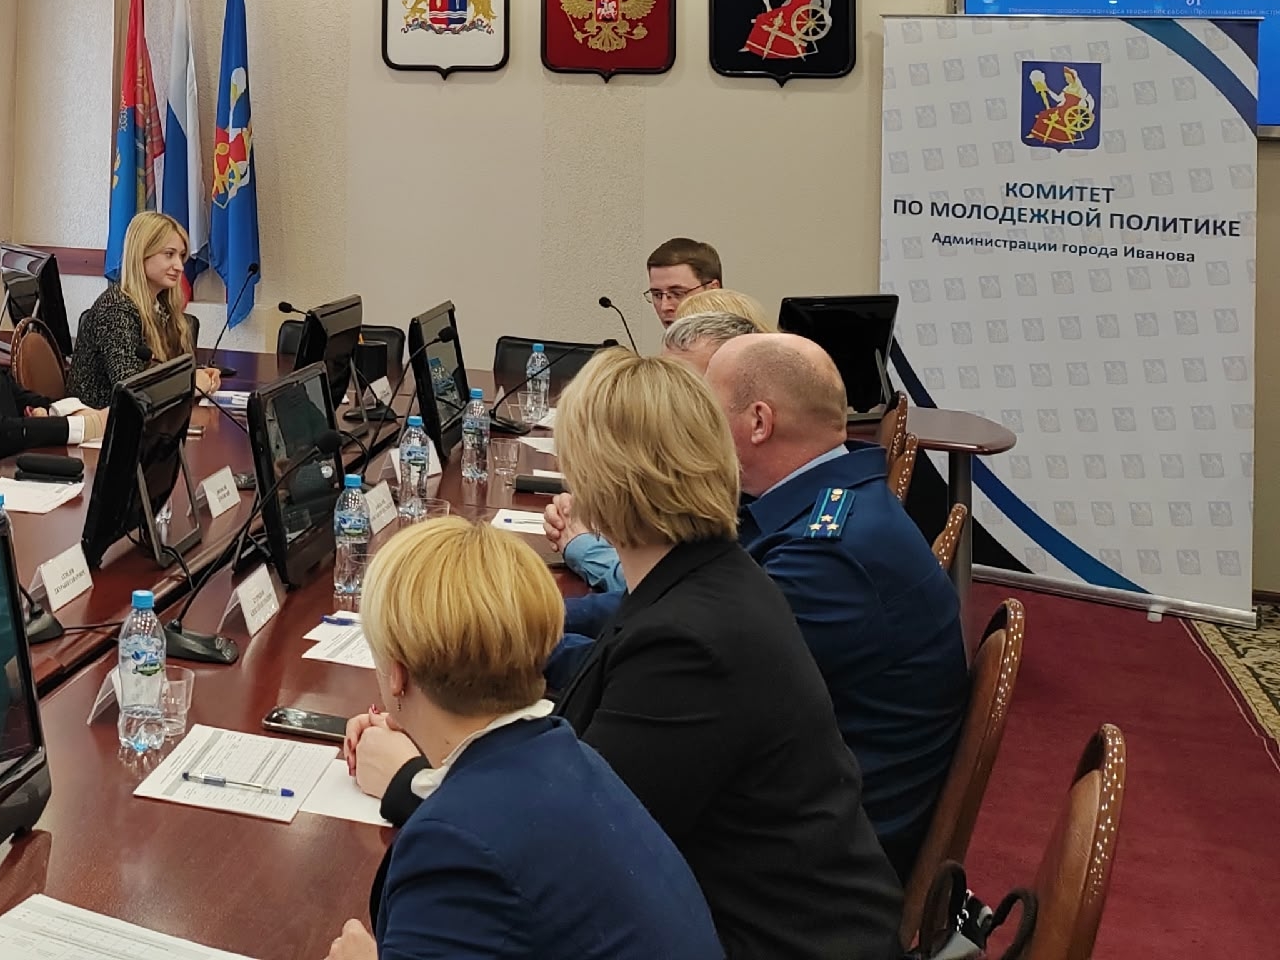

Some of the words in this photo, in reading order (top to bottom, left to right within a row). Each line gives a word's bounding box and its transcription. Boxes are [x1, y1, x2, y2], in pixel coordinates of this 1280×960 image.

[1006, 182, 1115, 203] КОМИТЕТ
[893, 199, 923, 215] ПО
[930, 202, 1101, 228] МОЛОДЕЖНОЙ
[1109, 213, 1241, 237] ПОЛИТИКЕ
[931, 232, 1057, 253] Администрации
[1062, 244, 1118, 259] города
[1123, 246, 1195, 262] Иванова
